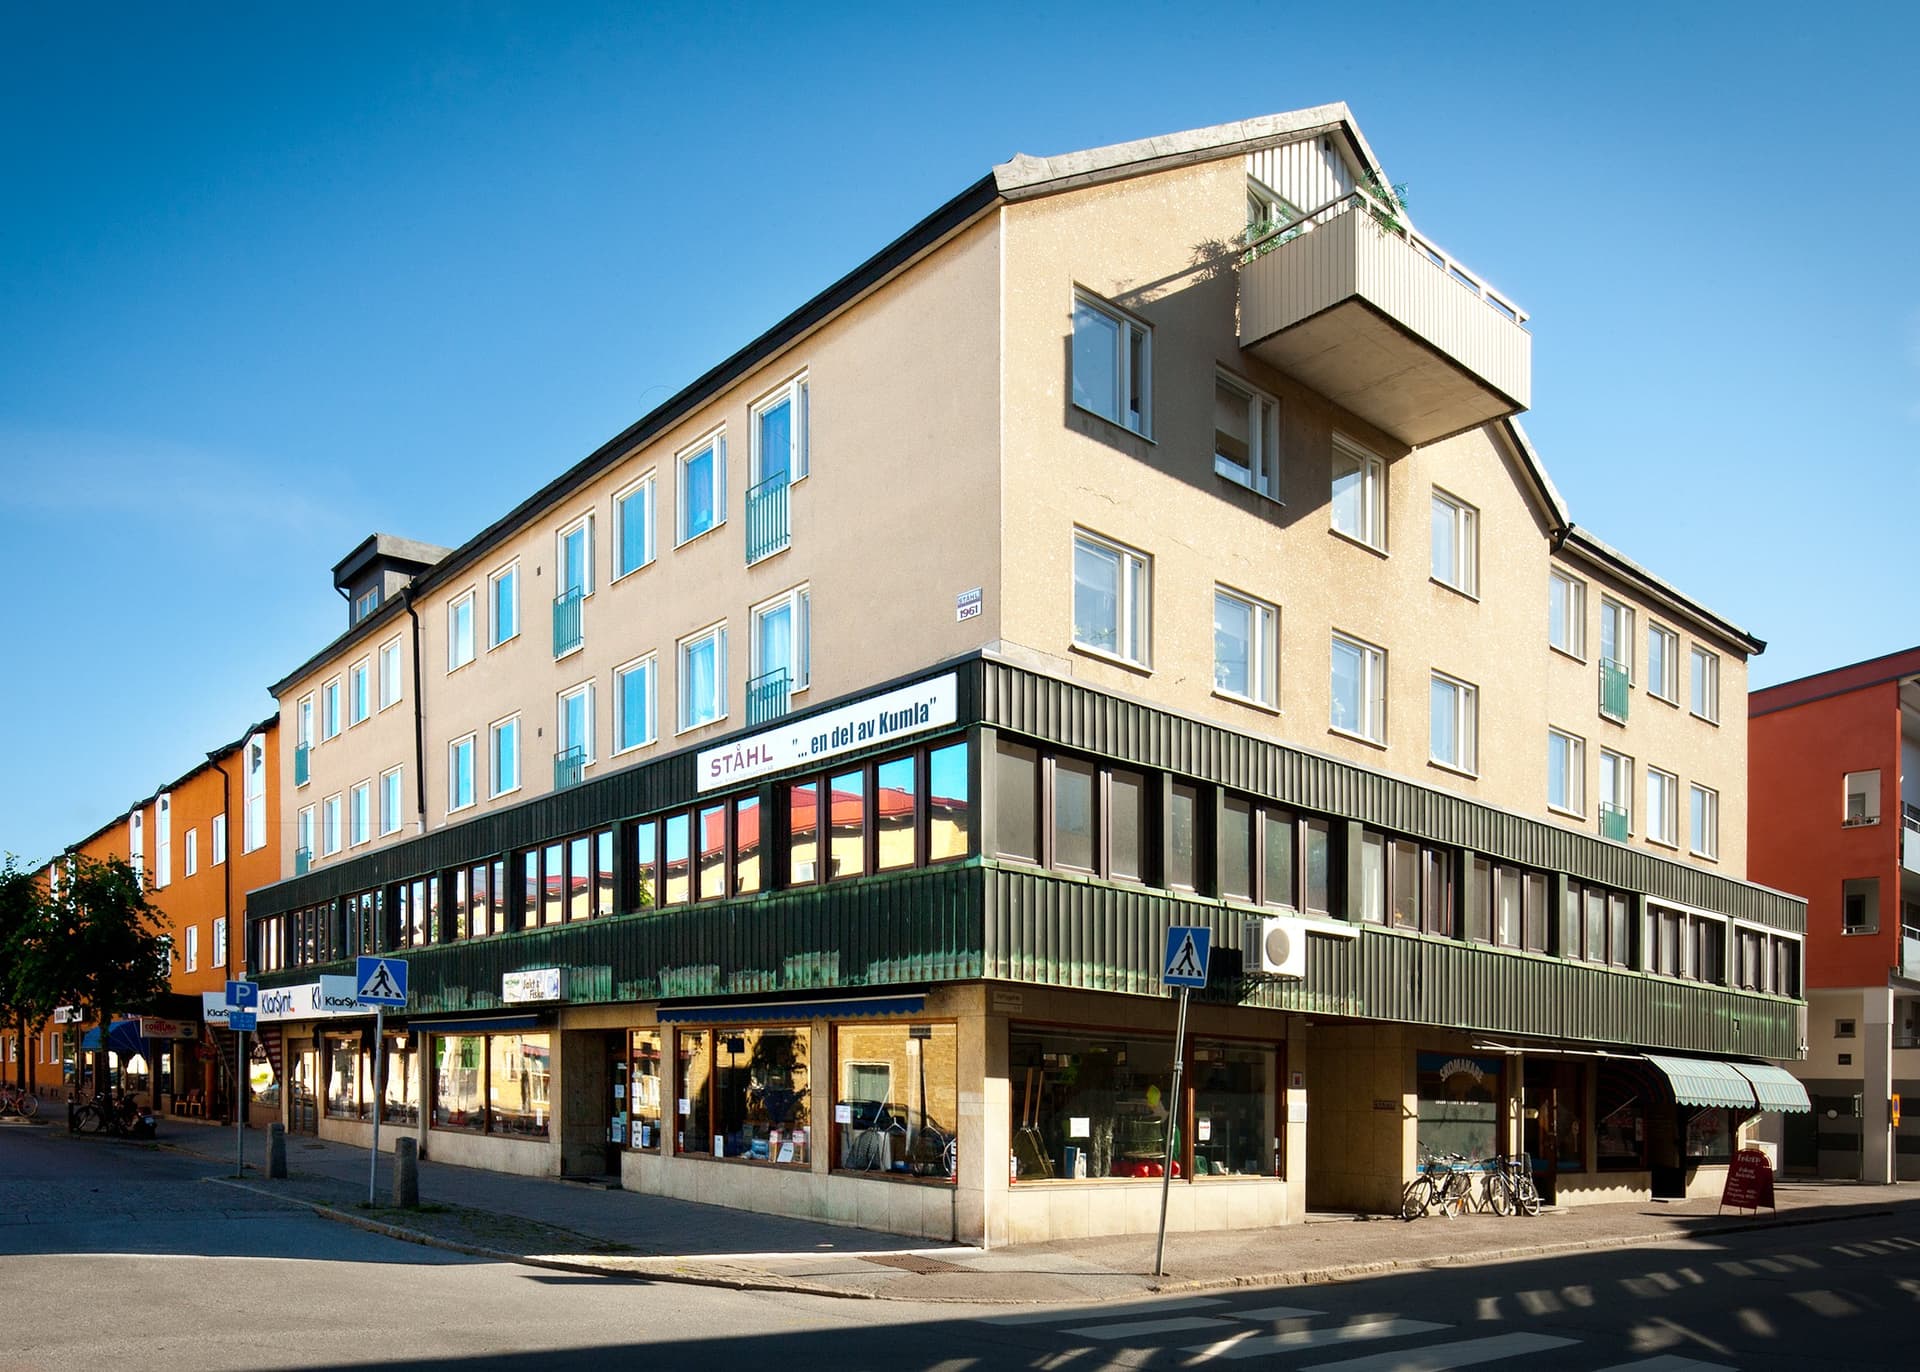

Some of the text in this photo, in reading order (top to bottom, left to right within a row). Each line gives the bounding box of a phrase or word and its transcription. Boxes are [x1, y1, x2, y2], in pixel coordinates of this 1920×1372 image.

[960, 604, 978, 619] 1961
[711, 743, 774, 777] STÅHL
[811, 732, 828, 754] en
[831, 720, 854, 749] del
[857, 718, 875, 741] av
[879, 696, 937, 735] Kumla"
[236, 984, 250, 1004] P
